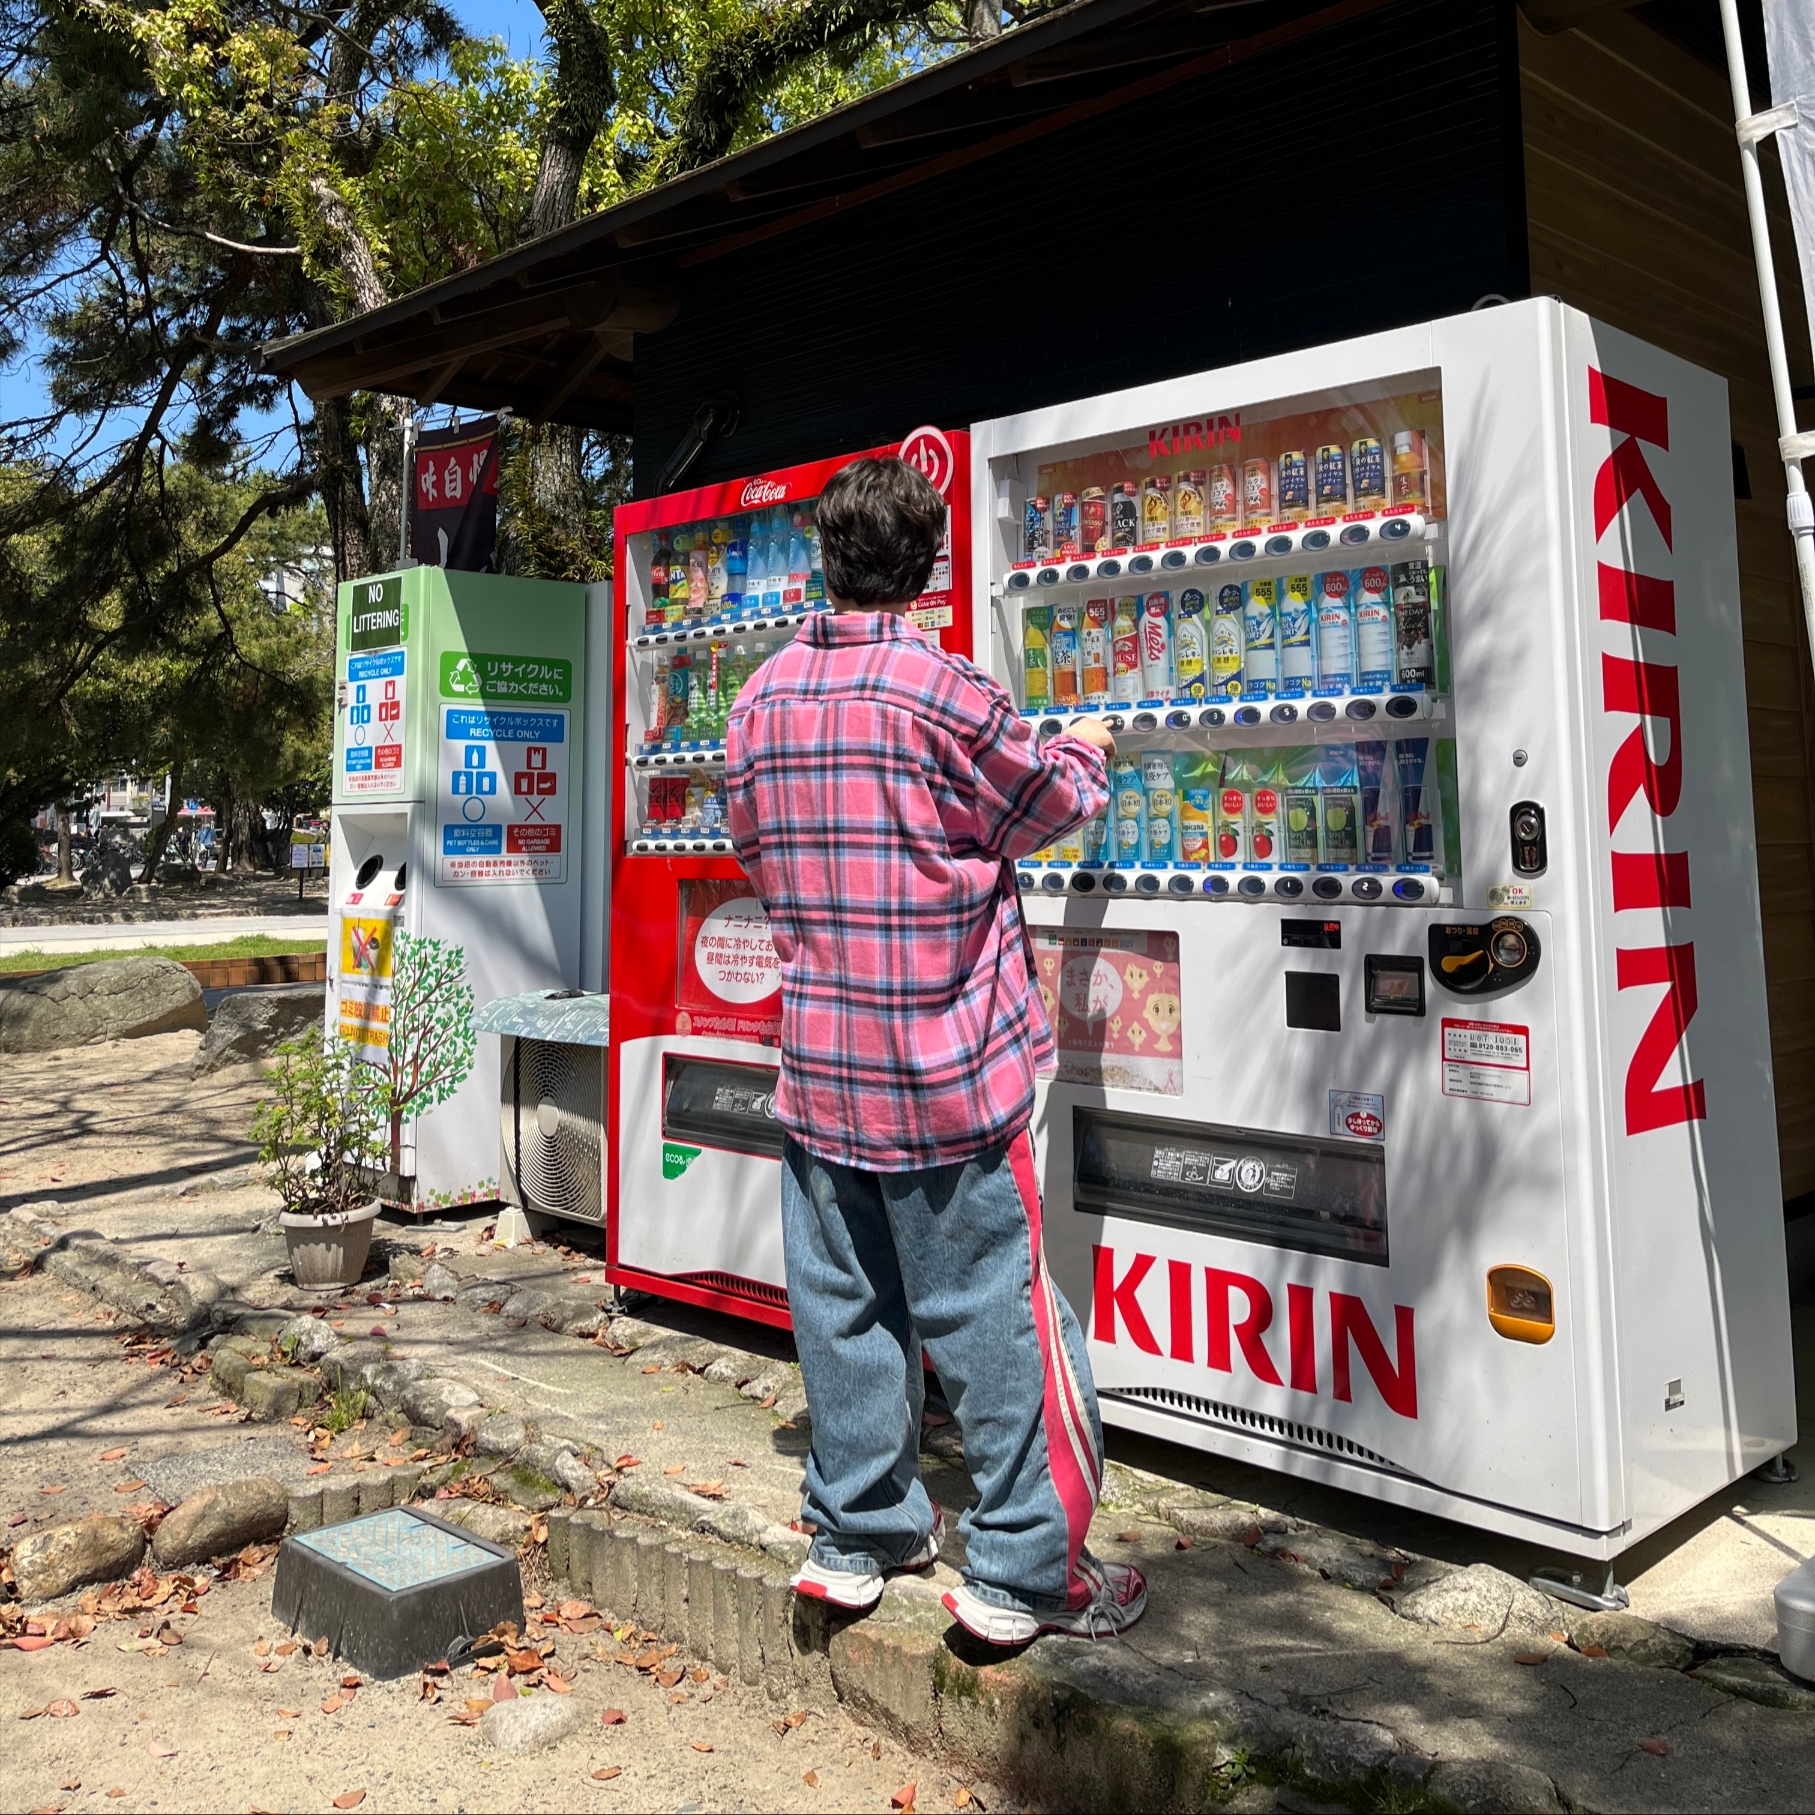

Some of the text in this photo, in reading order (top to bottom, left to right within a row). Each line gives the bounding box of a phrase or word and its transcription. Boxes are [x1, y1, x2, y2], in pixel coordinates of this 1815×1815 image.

[1149, 412, 1241, 459] KIRIN
[740, 480, 788, 506] Coca-Cola
[1113, 518, 1135, 528] LACK
[368, 584, 383, 604] NO
[1256, 588, 1272, 596] 555
[1290, 583, 1307, 592] 555
[353, 609, 399, 633] LITTERING
[1090, 608, 1105, 617] 555
[1320, 613, 1341, 622] KIRIN
[1358, 609, 1380, 618] KIRIN
[359, 667, 393, 678] RECYCLE ONLY
[488, 661, 563, 680] リサイクルに
[486, 680, 563, 697] ご協力ください。
[452, 714, 558, 727] これはリサイクルボックスです
[470, 728, 540, 739] RECYCLE ONLY
[1588, 363, 1707, 1137] KIRIN
[513, 828, 556, 837] その他のゴミ
[706, 952, 780, 969] 昼間は冷やす電気を
[1066, 966, 1114, 990] まさか、
[1075, 992, 1108, 1013] 私が
[1092, 1244, 1418, 1420] KIRIN
